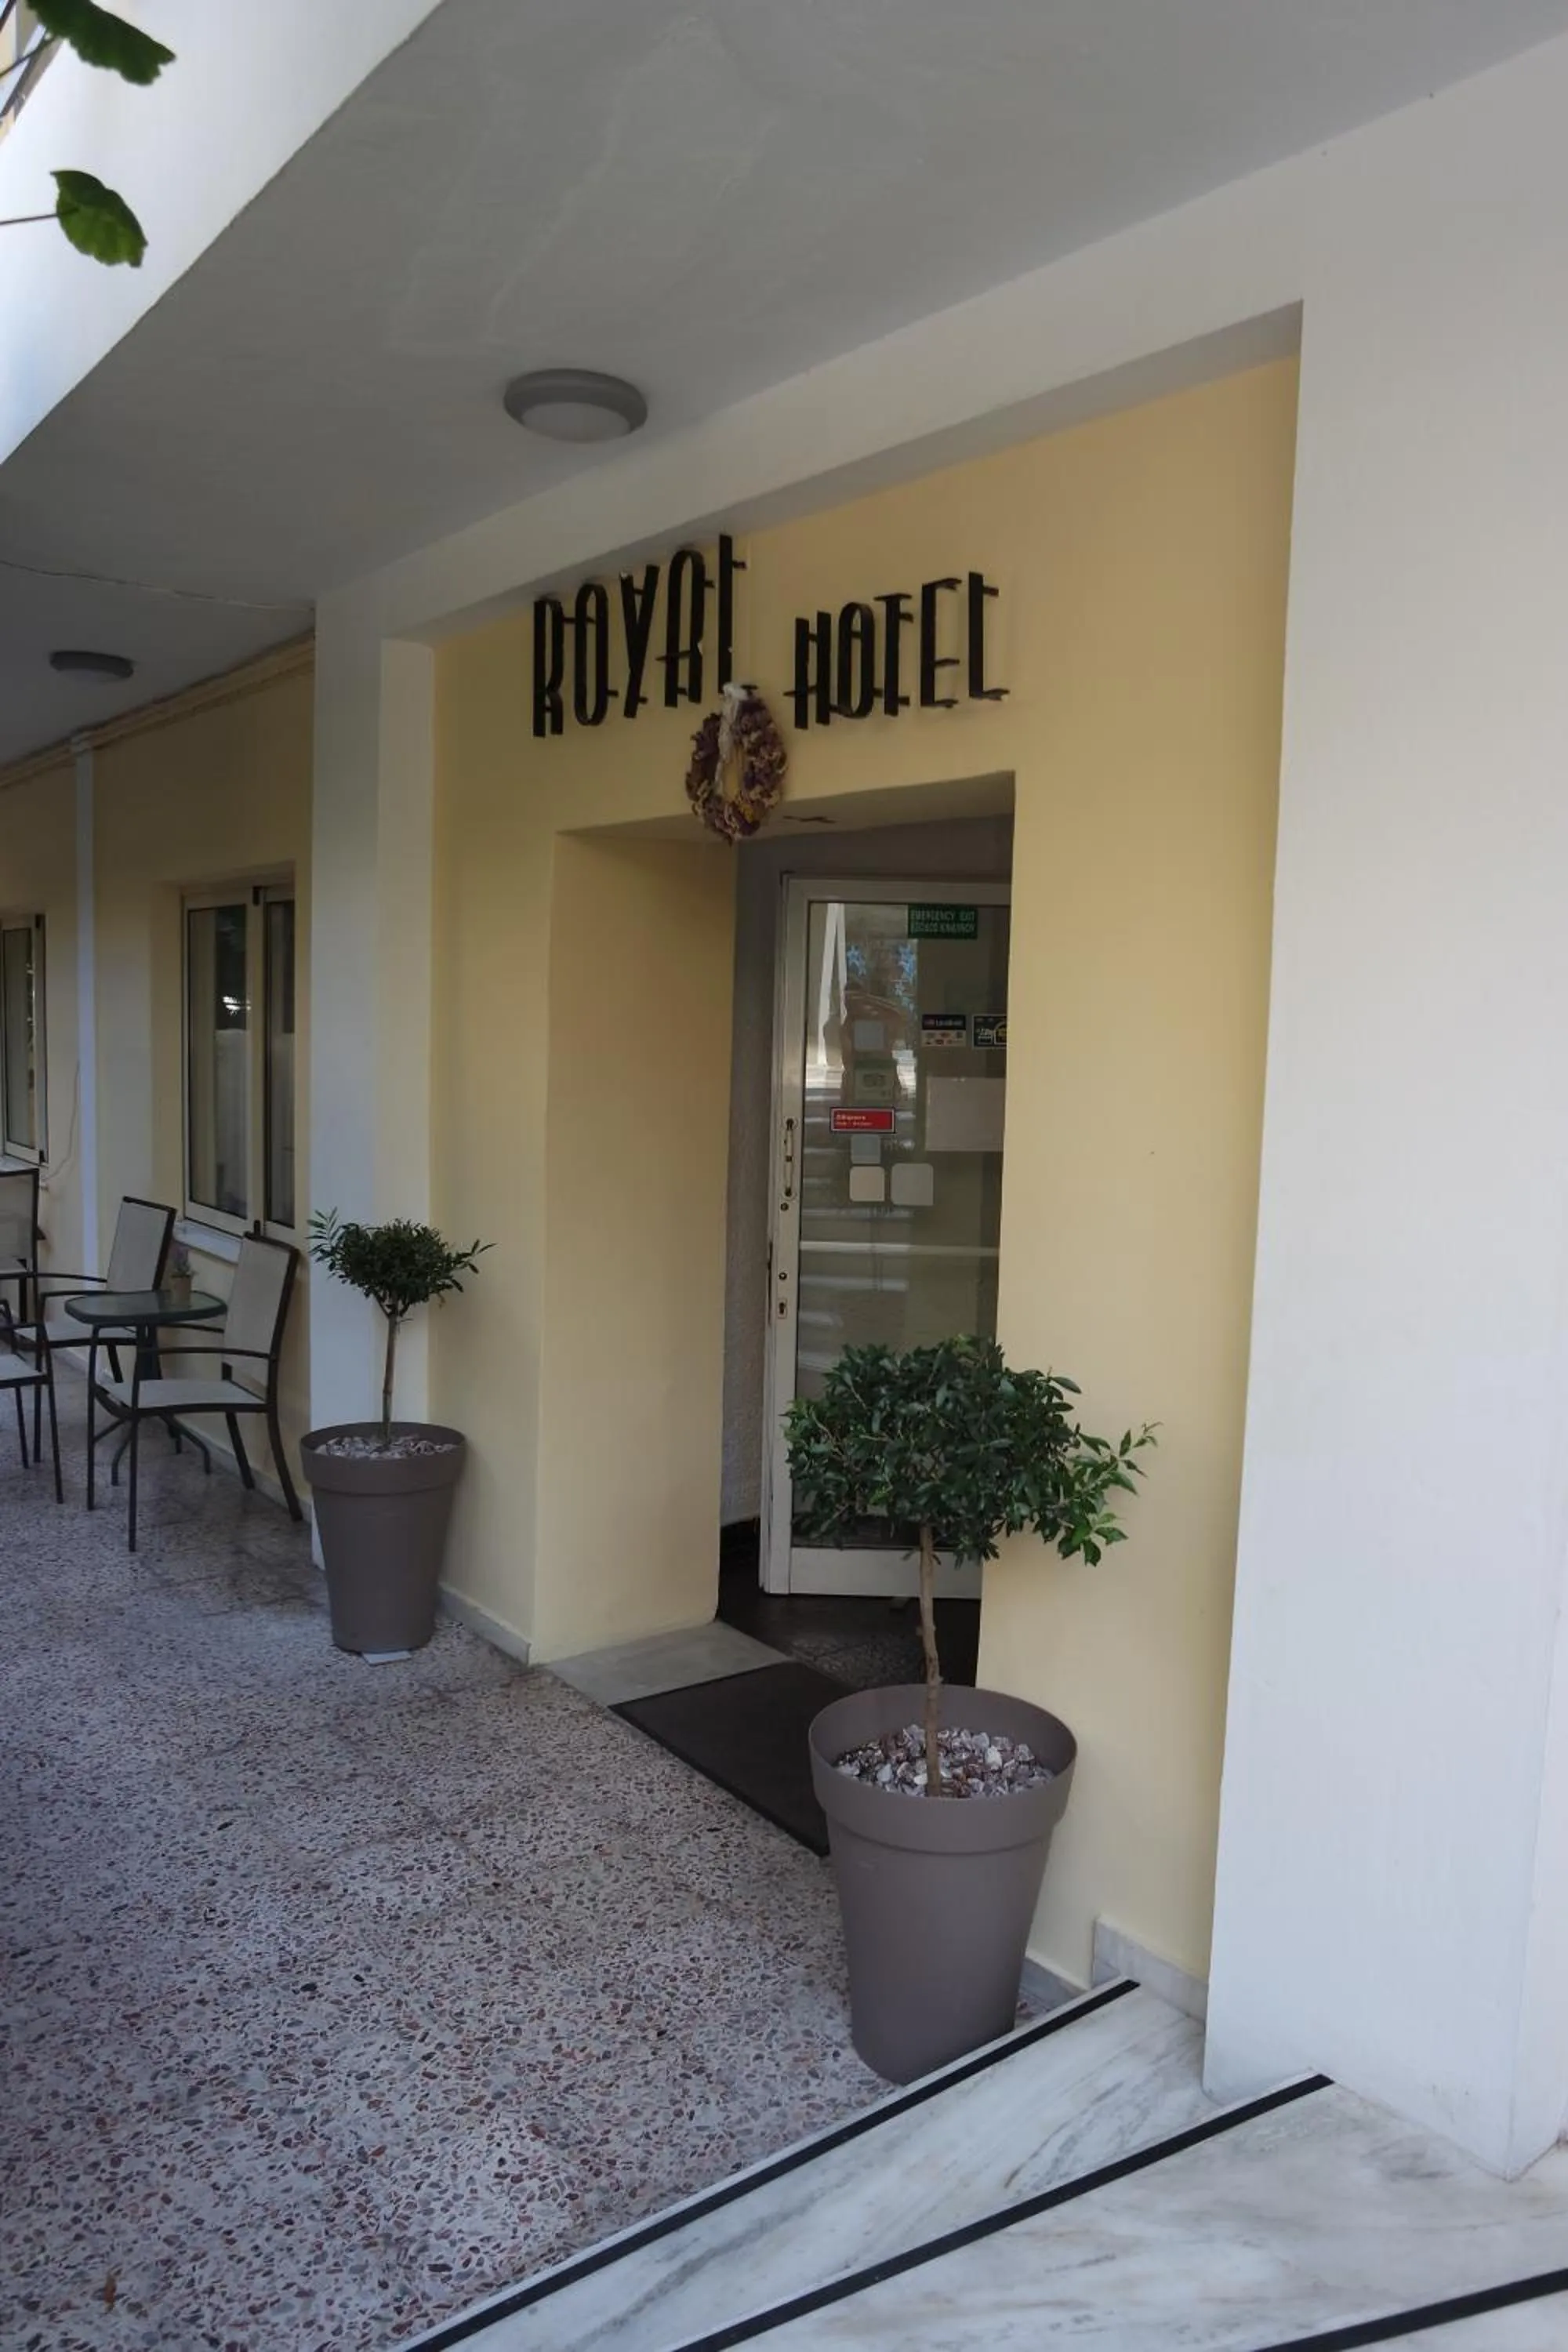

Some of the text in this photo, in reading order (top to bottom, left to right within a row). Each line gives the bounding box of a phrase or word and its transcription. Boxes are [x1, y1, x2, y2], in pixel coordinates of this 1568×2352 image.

[533, 534, 1009, 737] ROYAL HOTEL
[959, 910, 975, 921] EXIT
